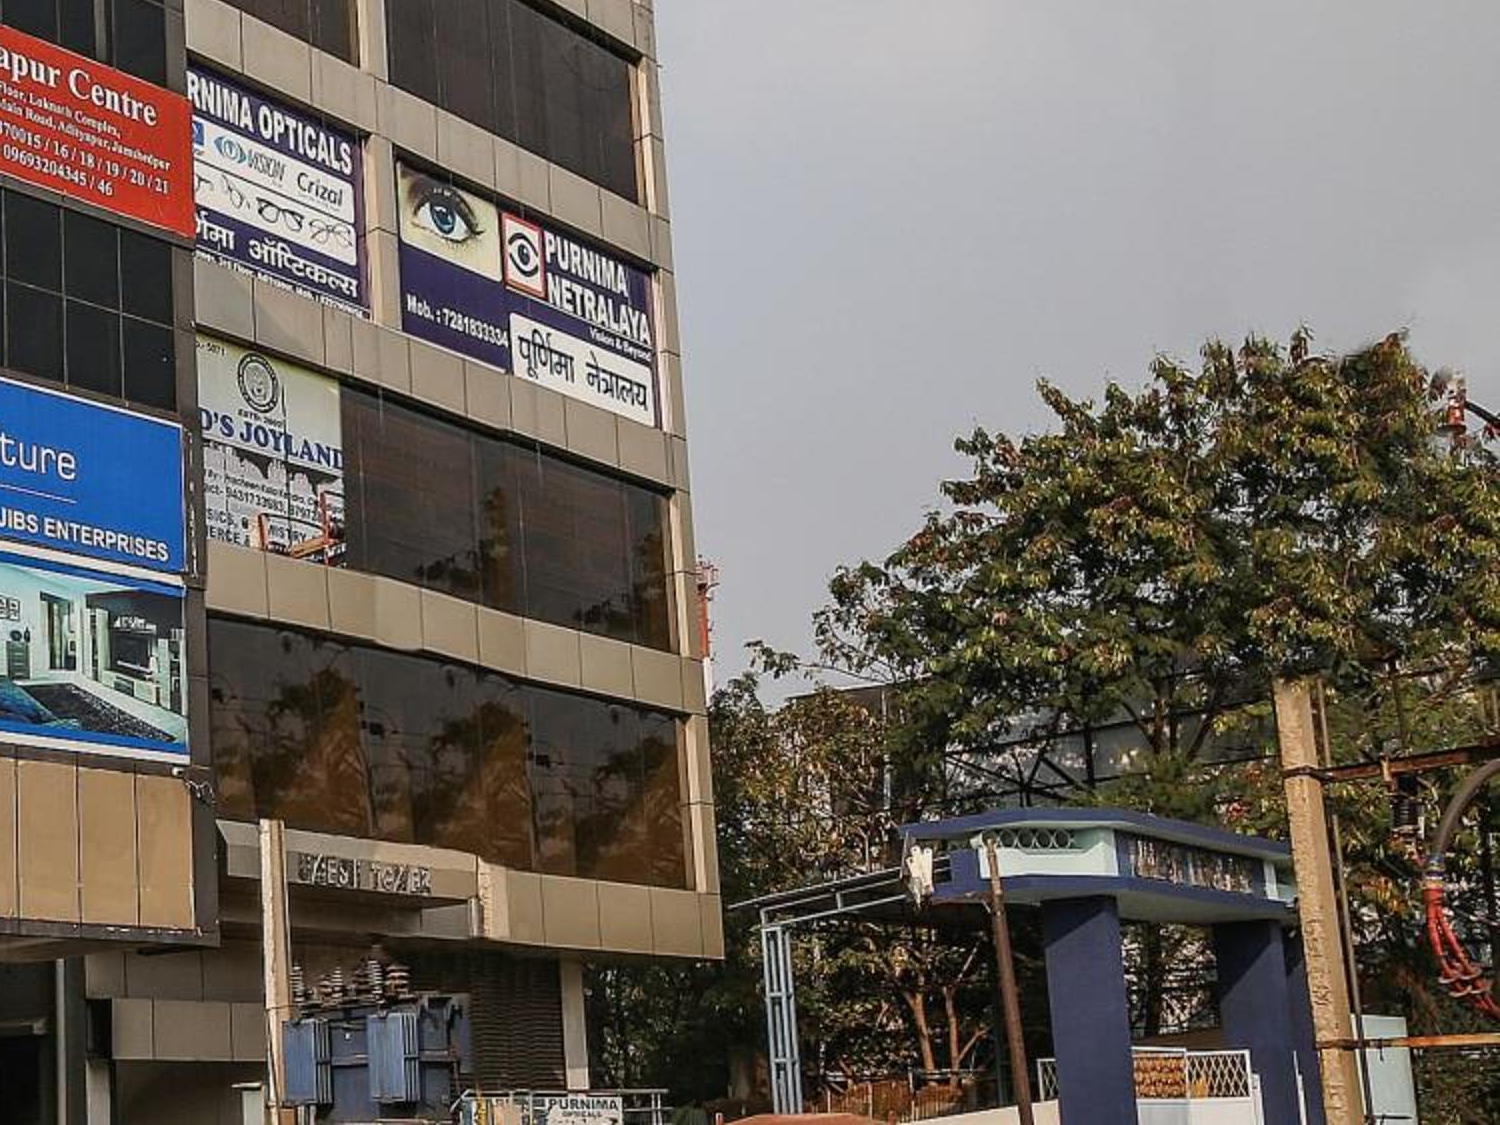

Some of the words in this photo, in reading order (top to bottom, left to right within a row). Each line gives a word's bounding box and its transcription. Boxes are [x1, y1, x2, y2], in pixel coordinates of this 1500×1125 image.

[68, 68, 158, 126] Centre
[53, 140, 69, 159] 16
[80, 151, 95, 168] 18
[105, 160, 120, 177] 19
[130, 168, 145, 186] 20
[155, 177, 169, 194] 21
[258, 106, 353, 176] OPTICALS
[97, 178, 113, 196] 46
[297, 172, 343, 207] Crizal
[545, 230, 629, 297] PURNIMA
[547, 273, 651, 345] NETRALAYA
[518, 328, 575, 384] पूर्णिमा
[585, 350, 648, 411] नेत्रालय
[43, 516, 169, 563] ENTERPRISES
[549, 1098, 619, 1111] PURNIMA
